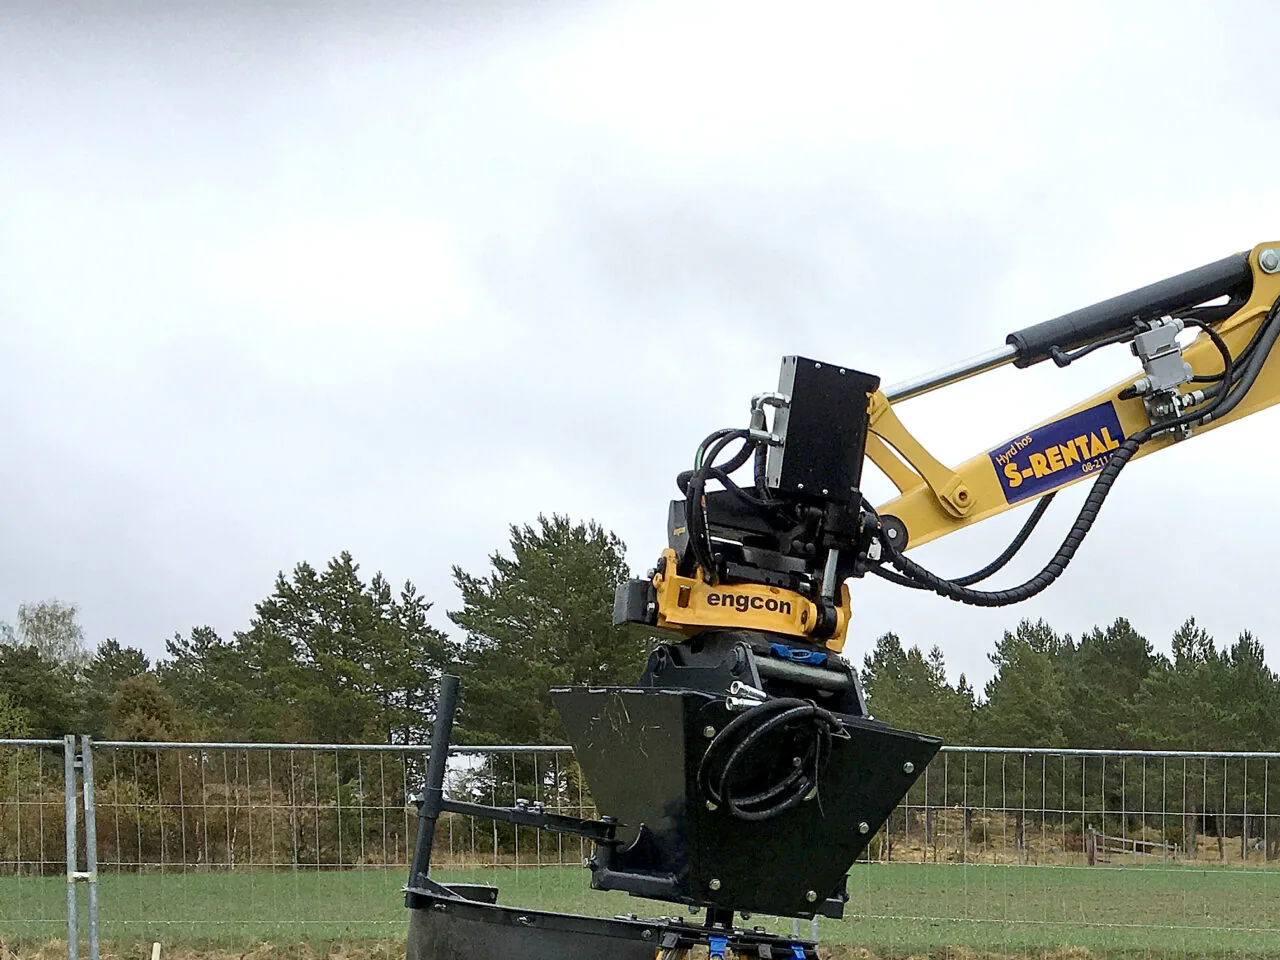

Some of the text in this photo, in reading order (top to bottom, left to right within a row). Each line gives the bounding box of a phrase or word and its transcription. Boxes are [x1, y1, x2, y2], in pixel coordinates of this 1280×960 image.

[996, 435, 1033, 466] Hyrd hos
[1004, 427, 1120, 488] S-RENTAL
[706, 593, 792, 615] engcon
